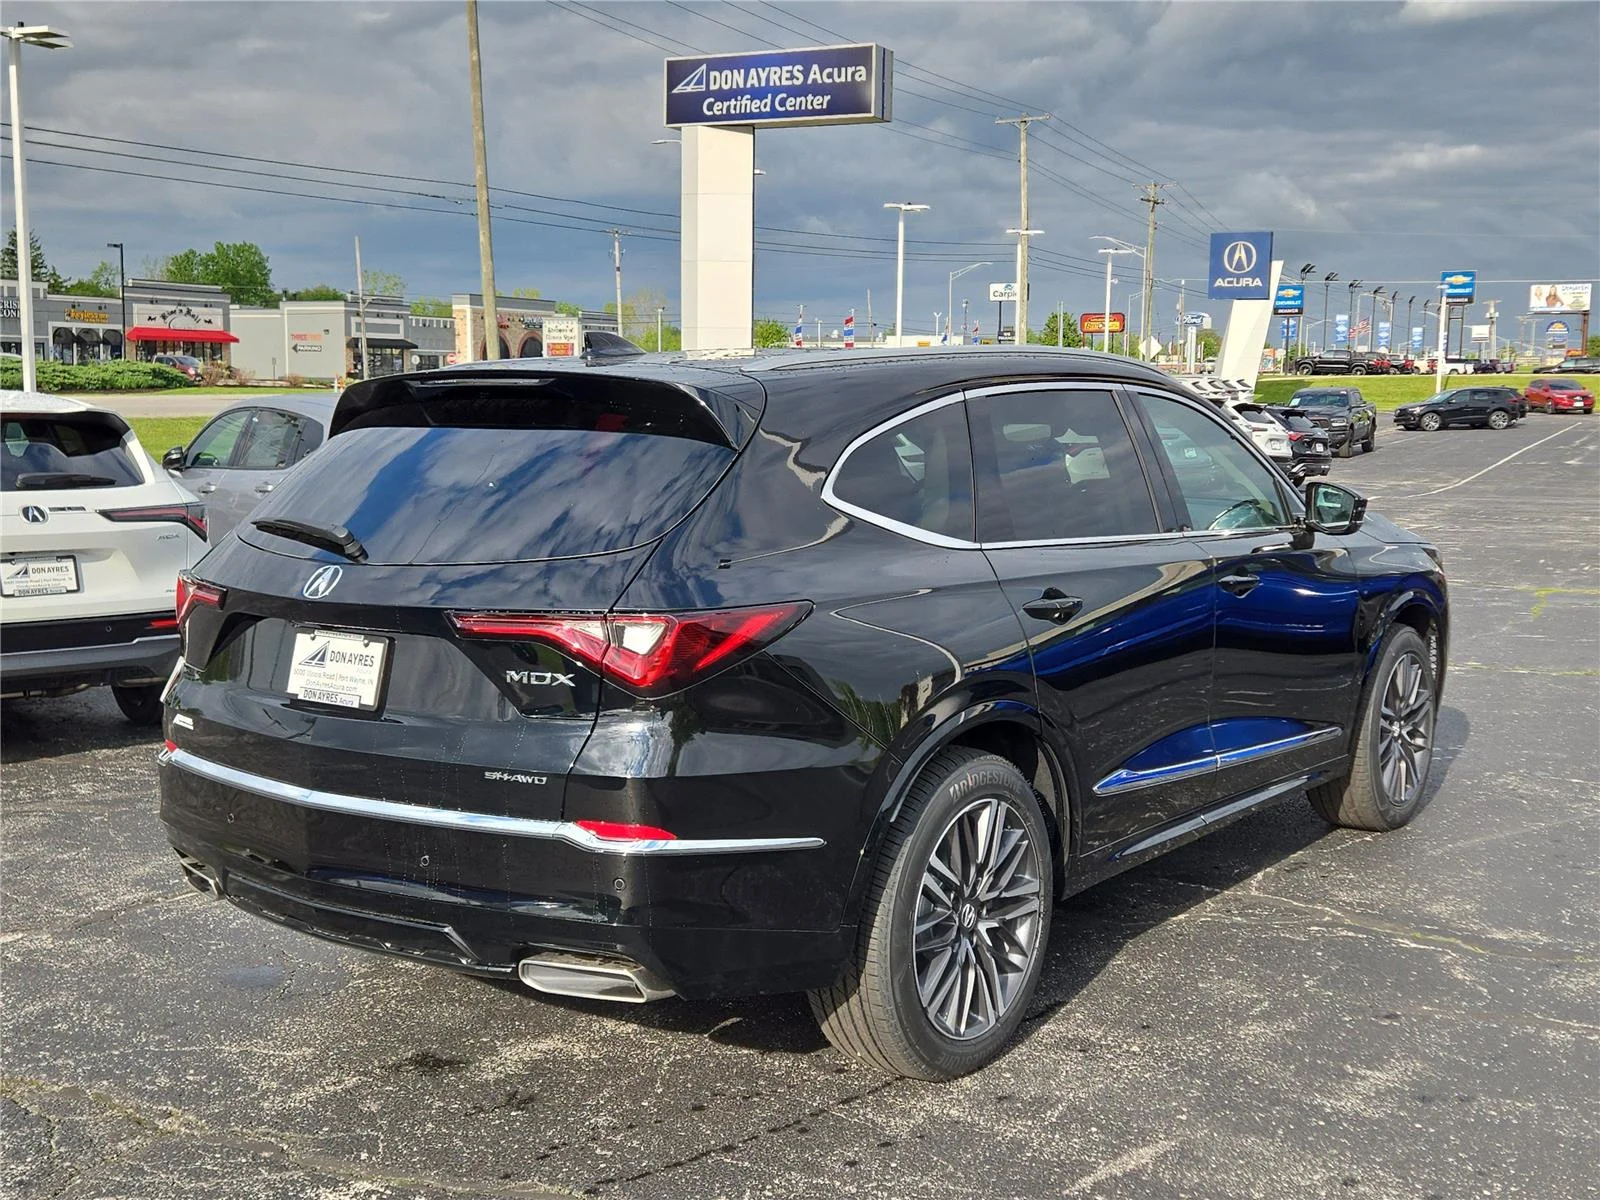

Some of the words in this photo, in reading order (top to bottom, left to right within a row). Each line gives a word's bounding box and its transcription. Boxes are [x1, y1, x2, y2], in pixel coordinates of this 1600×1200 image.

[709, 70, 745, 91] DON
[746, 65, 804, 88] AYRES
[807, 63, 867, 85] Acura
[702, 93, 771, 116] Certified
[774, 92, 832, 112] Center
[1213, 277, 1263, 287] ACURA
[31, 567, 46, 575] DON
[46, 565, 70, 574] AYRES
[329, 650, 348, 665] DON
[347, 653, 375, 668] AYRES
[505, 670, 576, 687] MDX
[303, 689, 318, 701] DON
[316, 692, 339, 704] AYRES
